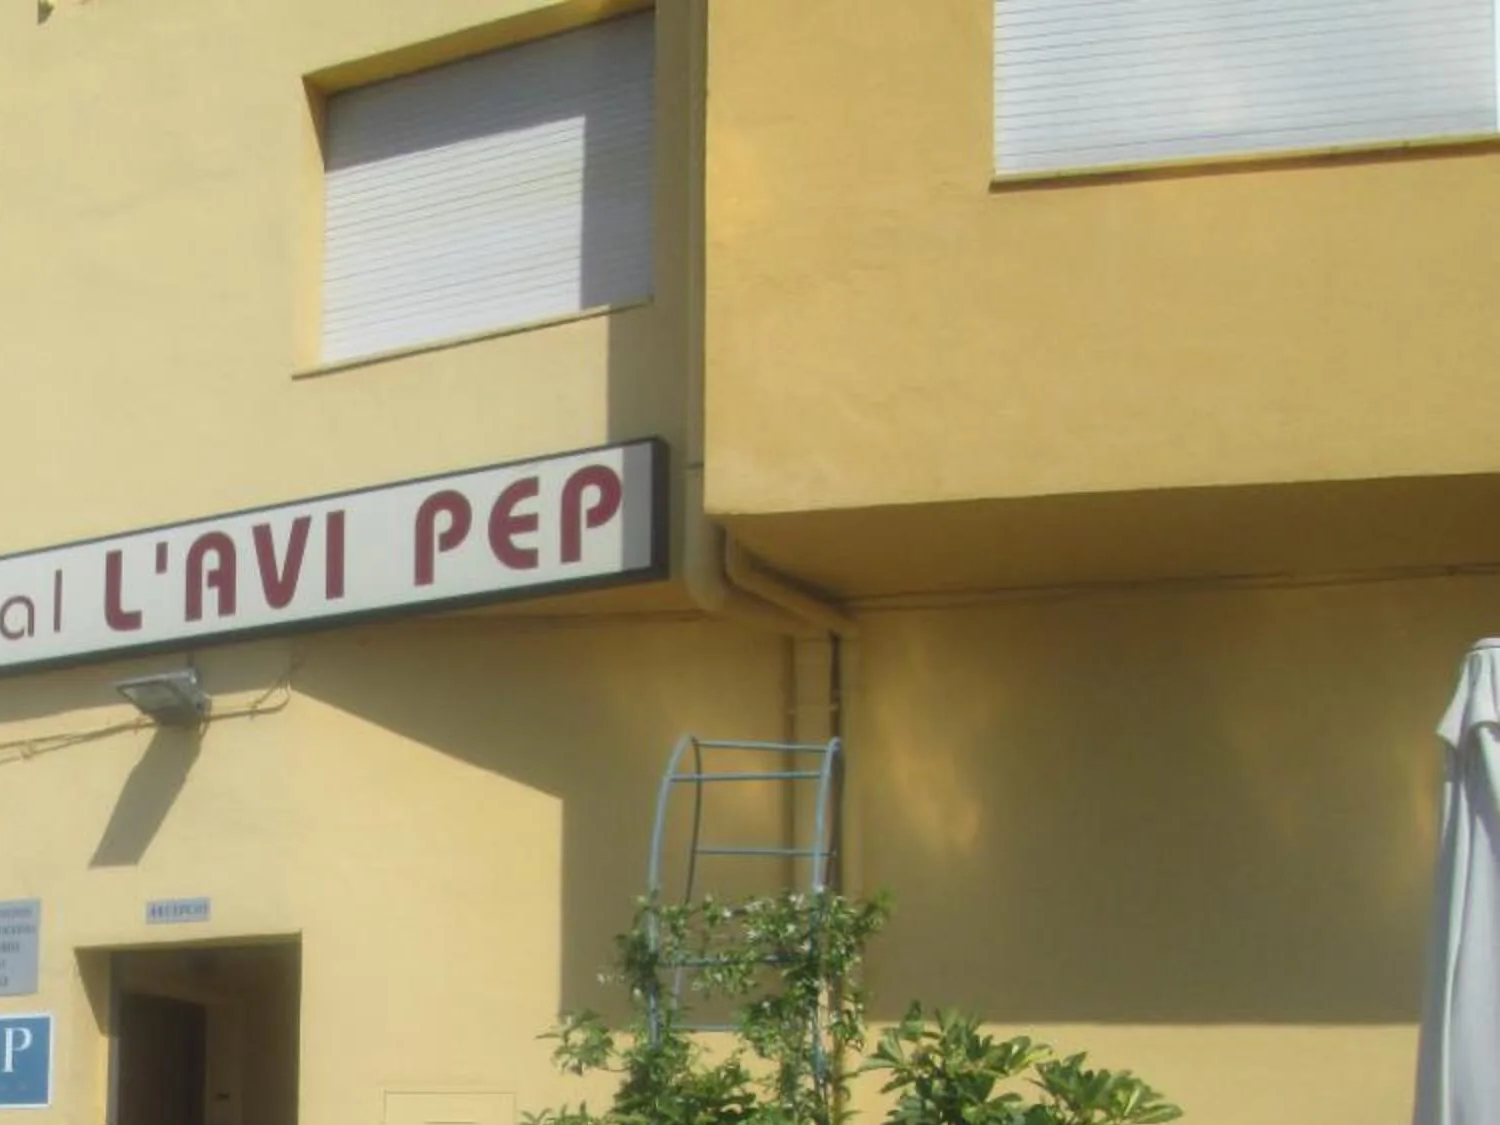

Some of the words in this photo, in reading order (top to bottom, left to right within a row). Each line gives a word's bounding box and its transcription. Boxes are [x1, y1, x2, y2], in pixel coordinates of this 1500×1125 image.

[104, 510, 346, 632] L'AVI
[413, 464, 623, 586] PEP
[1, 1026, 33, 1073] P
